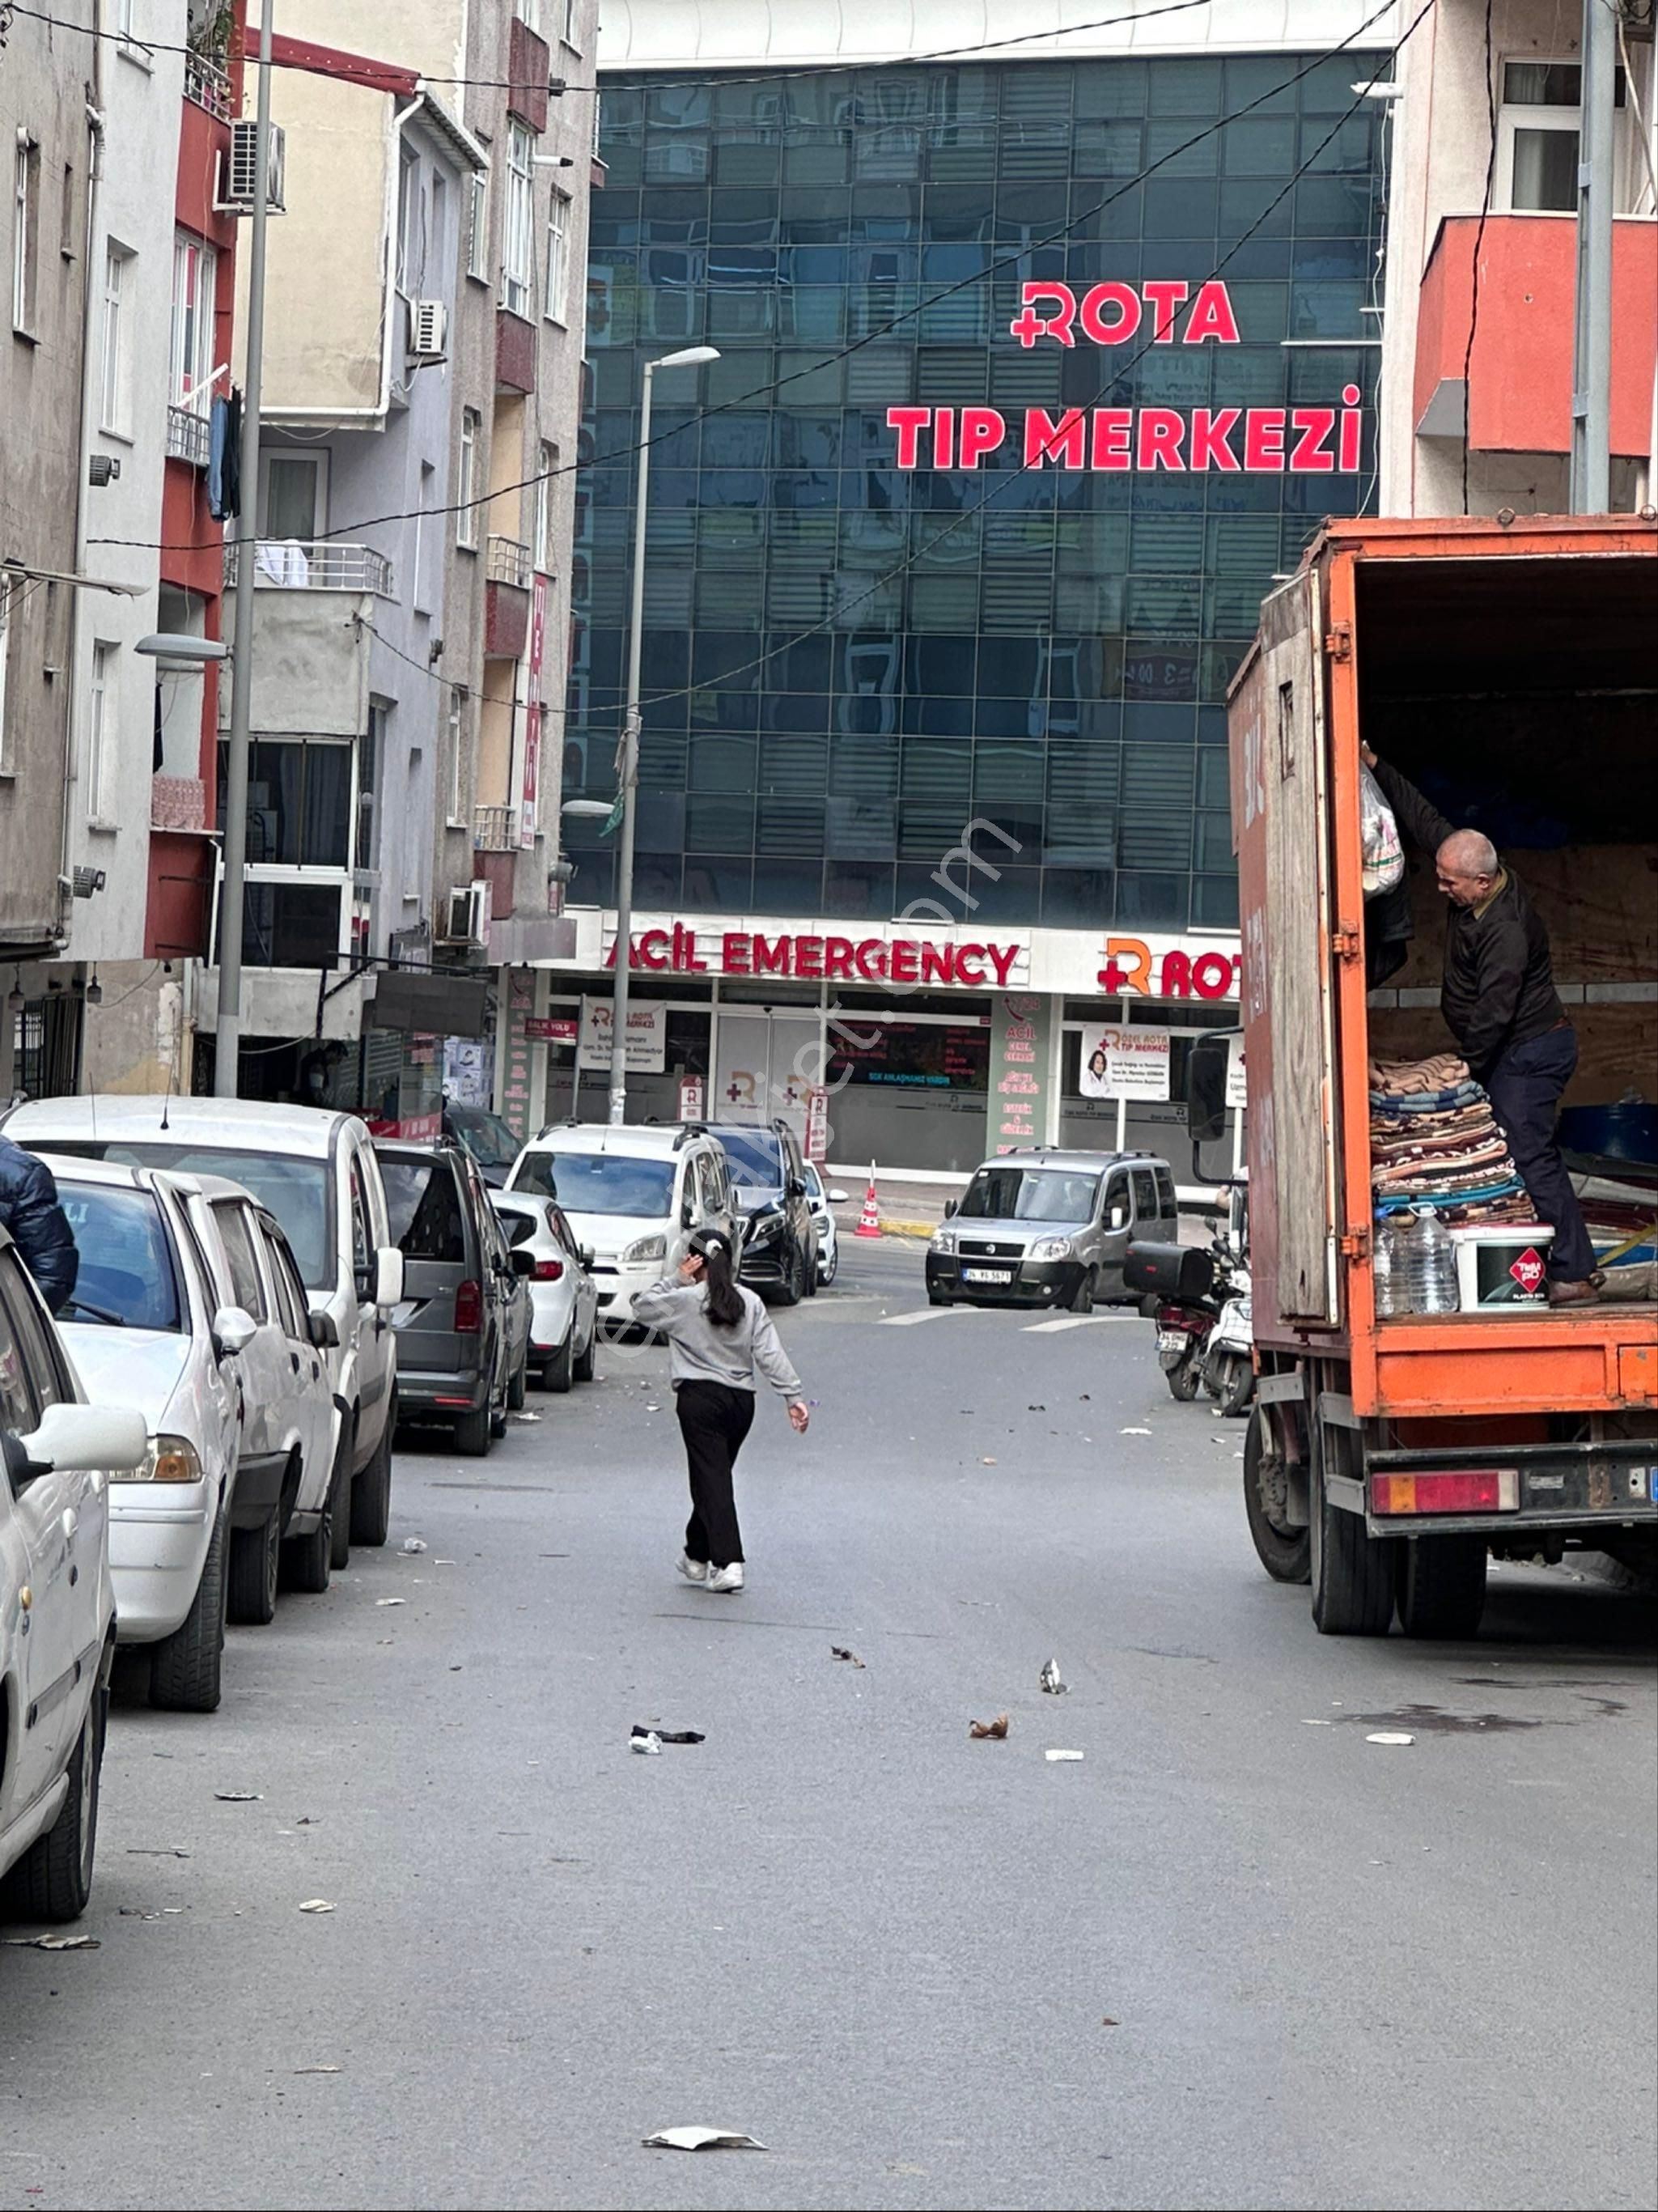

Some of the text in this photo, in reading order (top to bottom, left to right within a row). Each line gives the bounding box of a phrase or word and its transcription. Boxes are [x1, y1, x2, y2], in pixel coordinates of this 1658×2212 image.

[1012, 281, 1240, 348] ROTA
[887, 384, 1362, 472] TIP MERKEZİ
[606, 921, 1020, 987] ACİL EMERGENCY
[1006, 1023, 1037, 1040] ACİL
